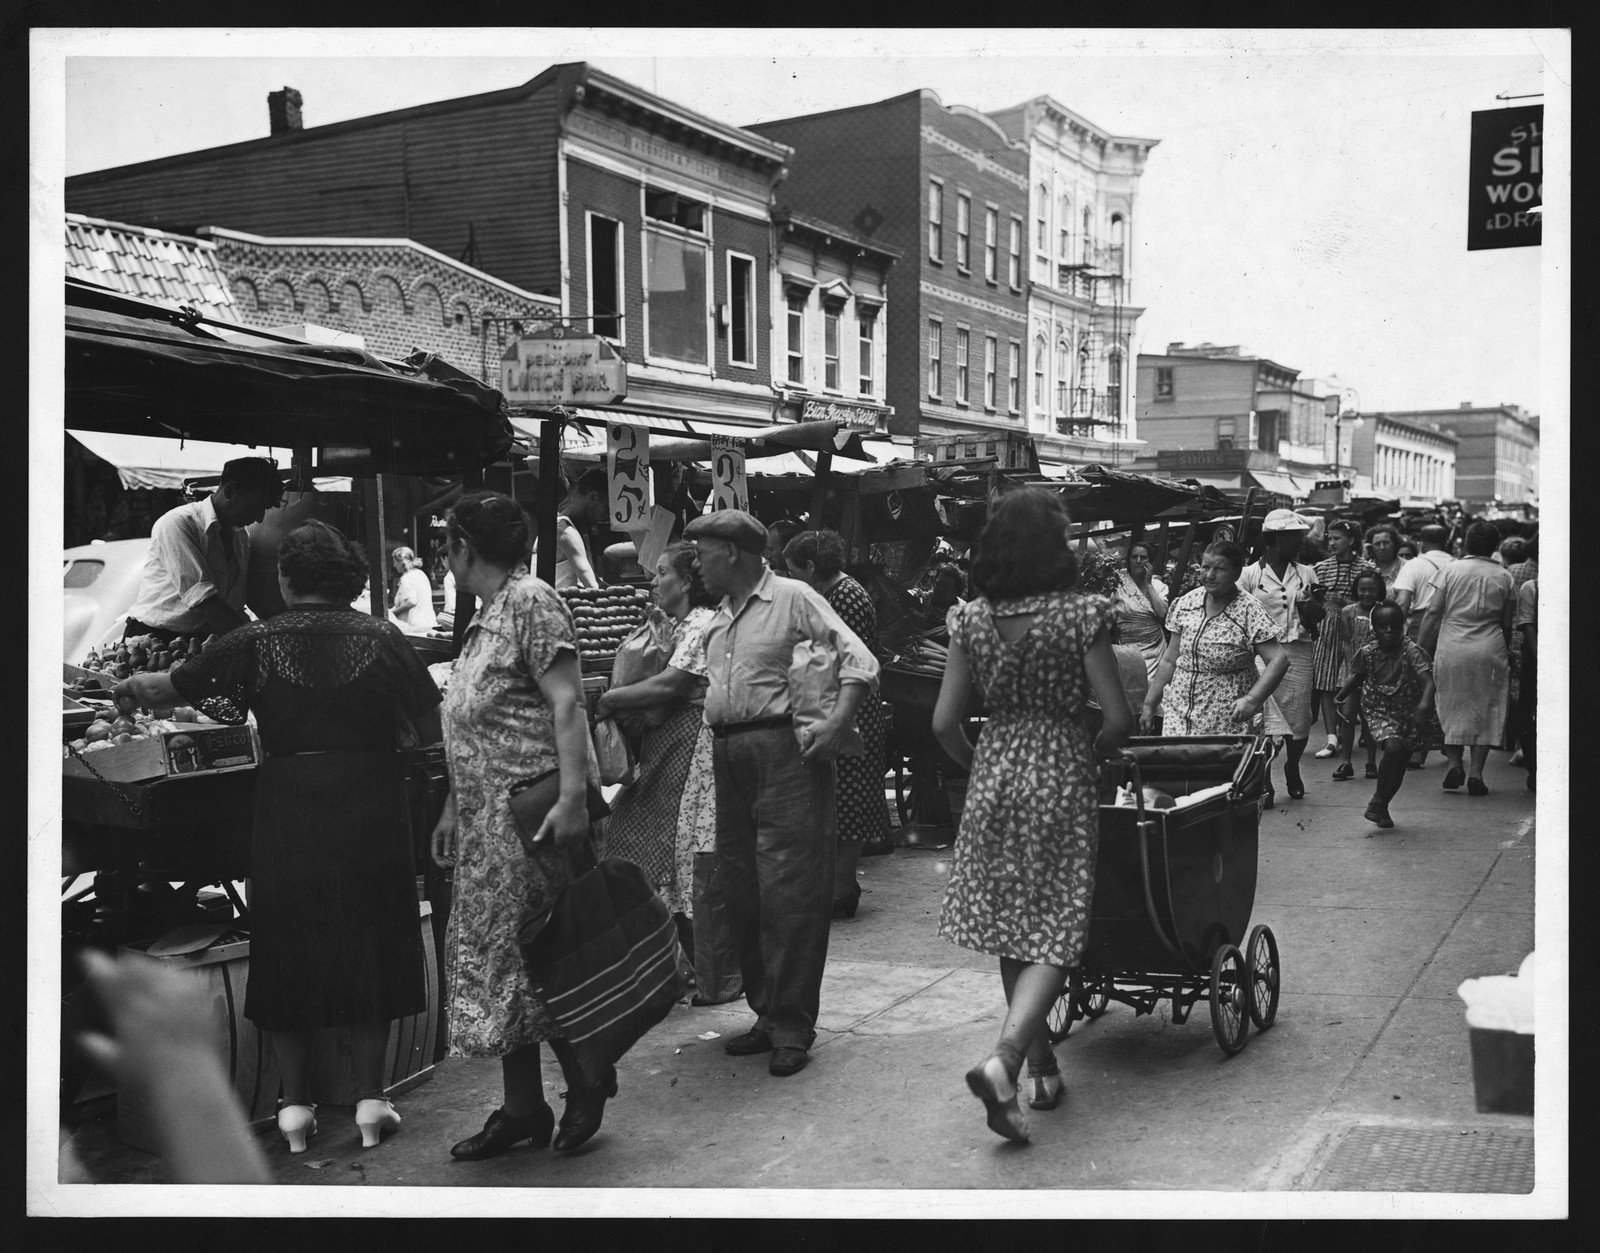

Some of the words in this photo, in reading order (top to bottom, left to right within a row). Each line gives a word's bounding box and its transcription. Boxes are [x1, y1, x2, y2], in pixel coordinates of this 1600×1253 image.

[1485, 182, 1543, 204] WO
[508, 368, 564, 392] LUNCH
[571, 372, 610, 394] BAR
